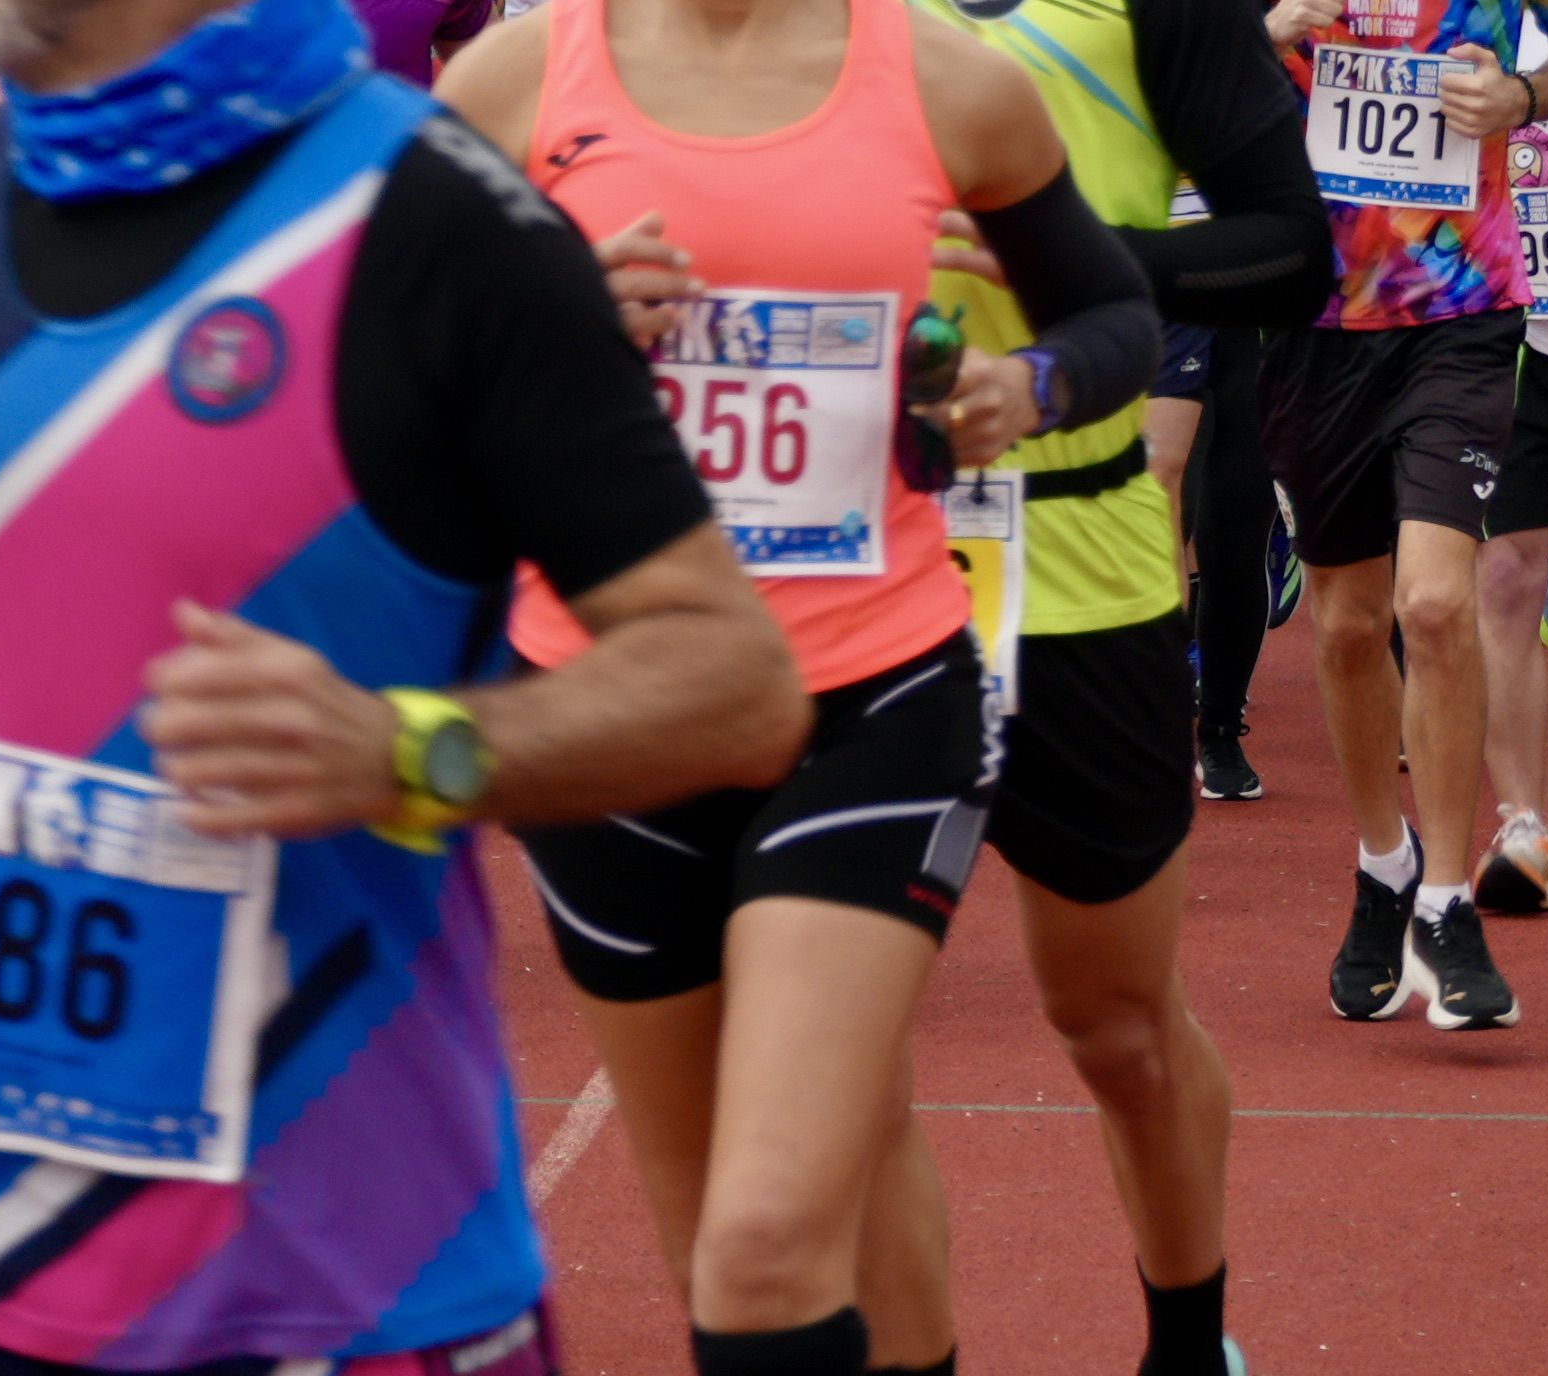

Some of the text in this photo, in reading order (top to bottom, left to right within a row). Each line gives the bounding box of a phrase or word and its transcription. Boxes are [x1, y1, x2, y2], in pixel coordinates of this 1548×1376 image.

[1357, 15, 1385, 37] 10K
[1334, 52, 1386, 94] 21K
[1333, 96, 1447, 161] 1021
